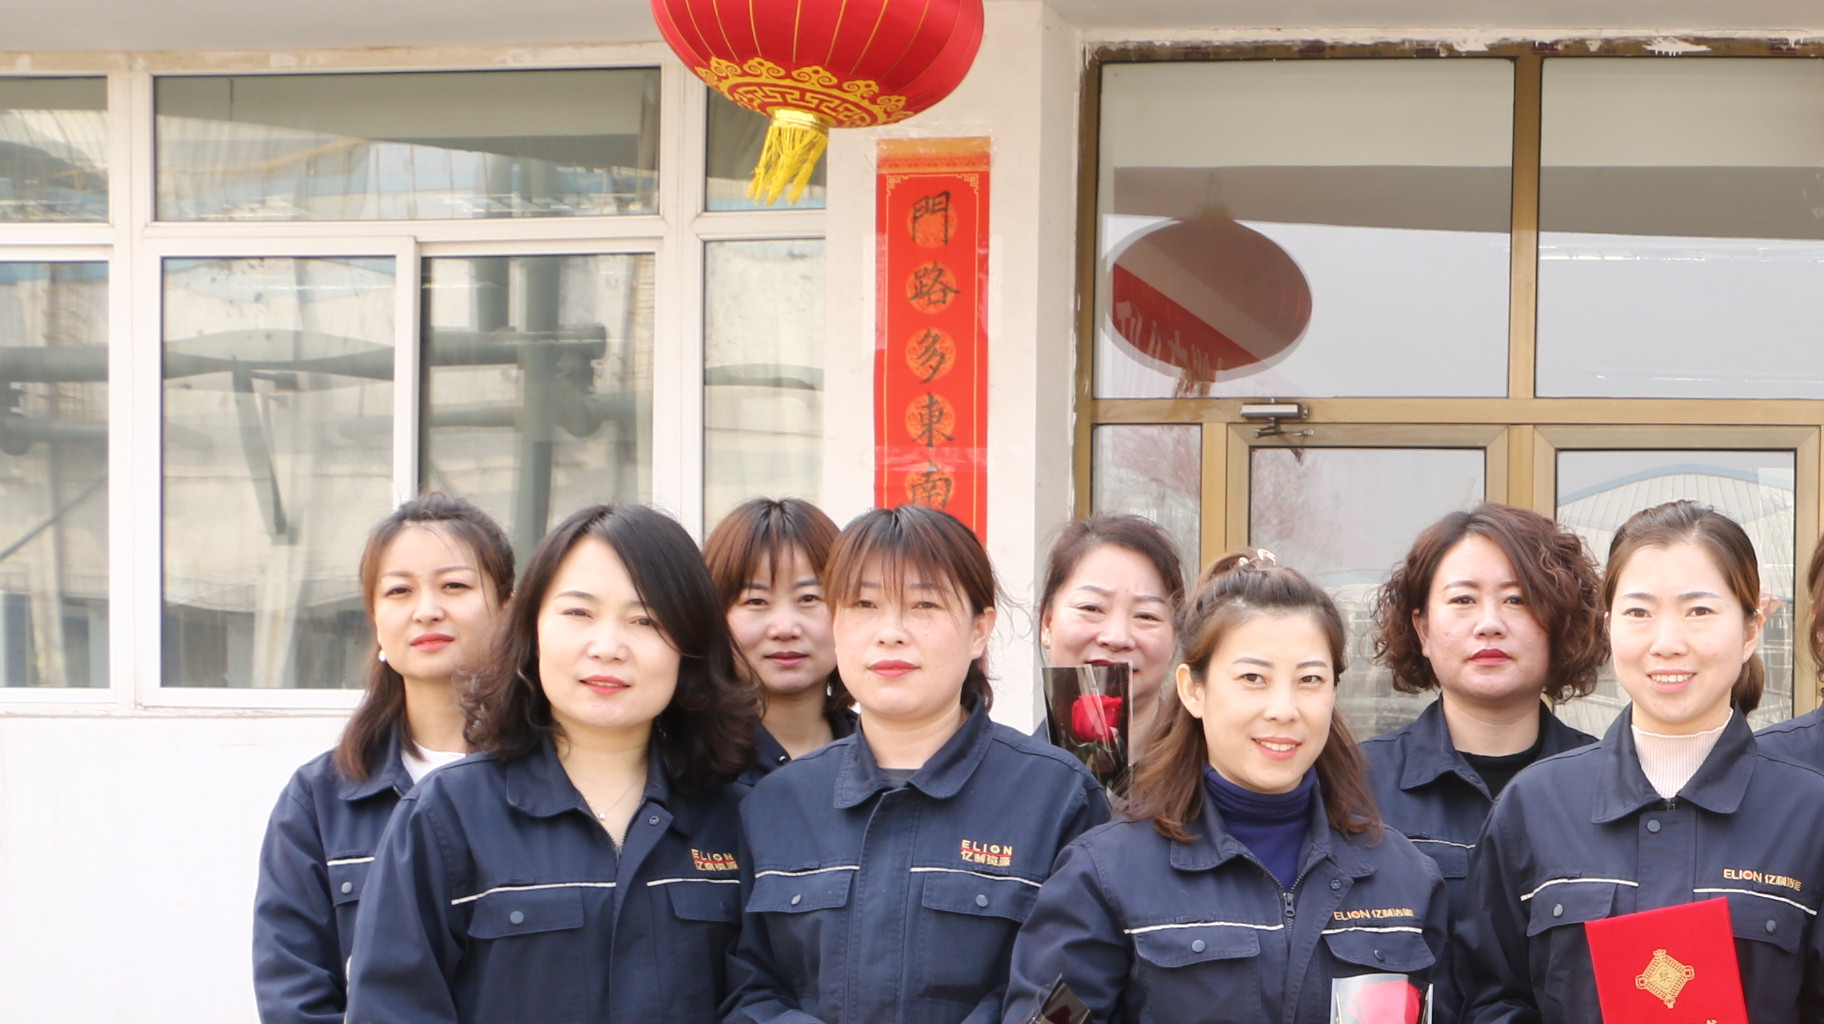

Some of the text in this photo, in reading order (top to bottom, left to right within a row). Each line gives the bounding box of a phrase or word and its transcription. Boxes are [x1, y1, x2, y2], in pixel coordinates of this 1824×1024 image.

[691, 848, 734, 861] ELION
[961, 839, 1013, 856] ELION
[1723, 868, 1762, 883] ELION
[1333, 909, 1371, 921] ELION
